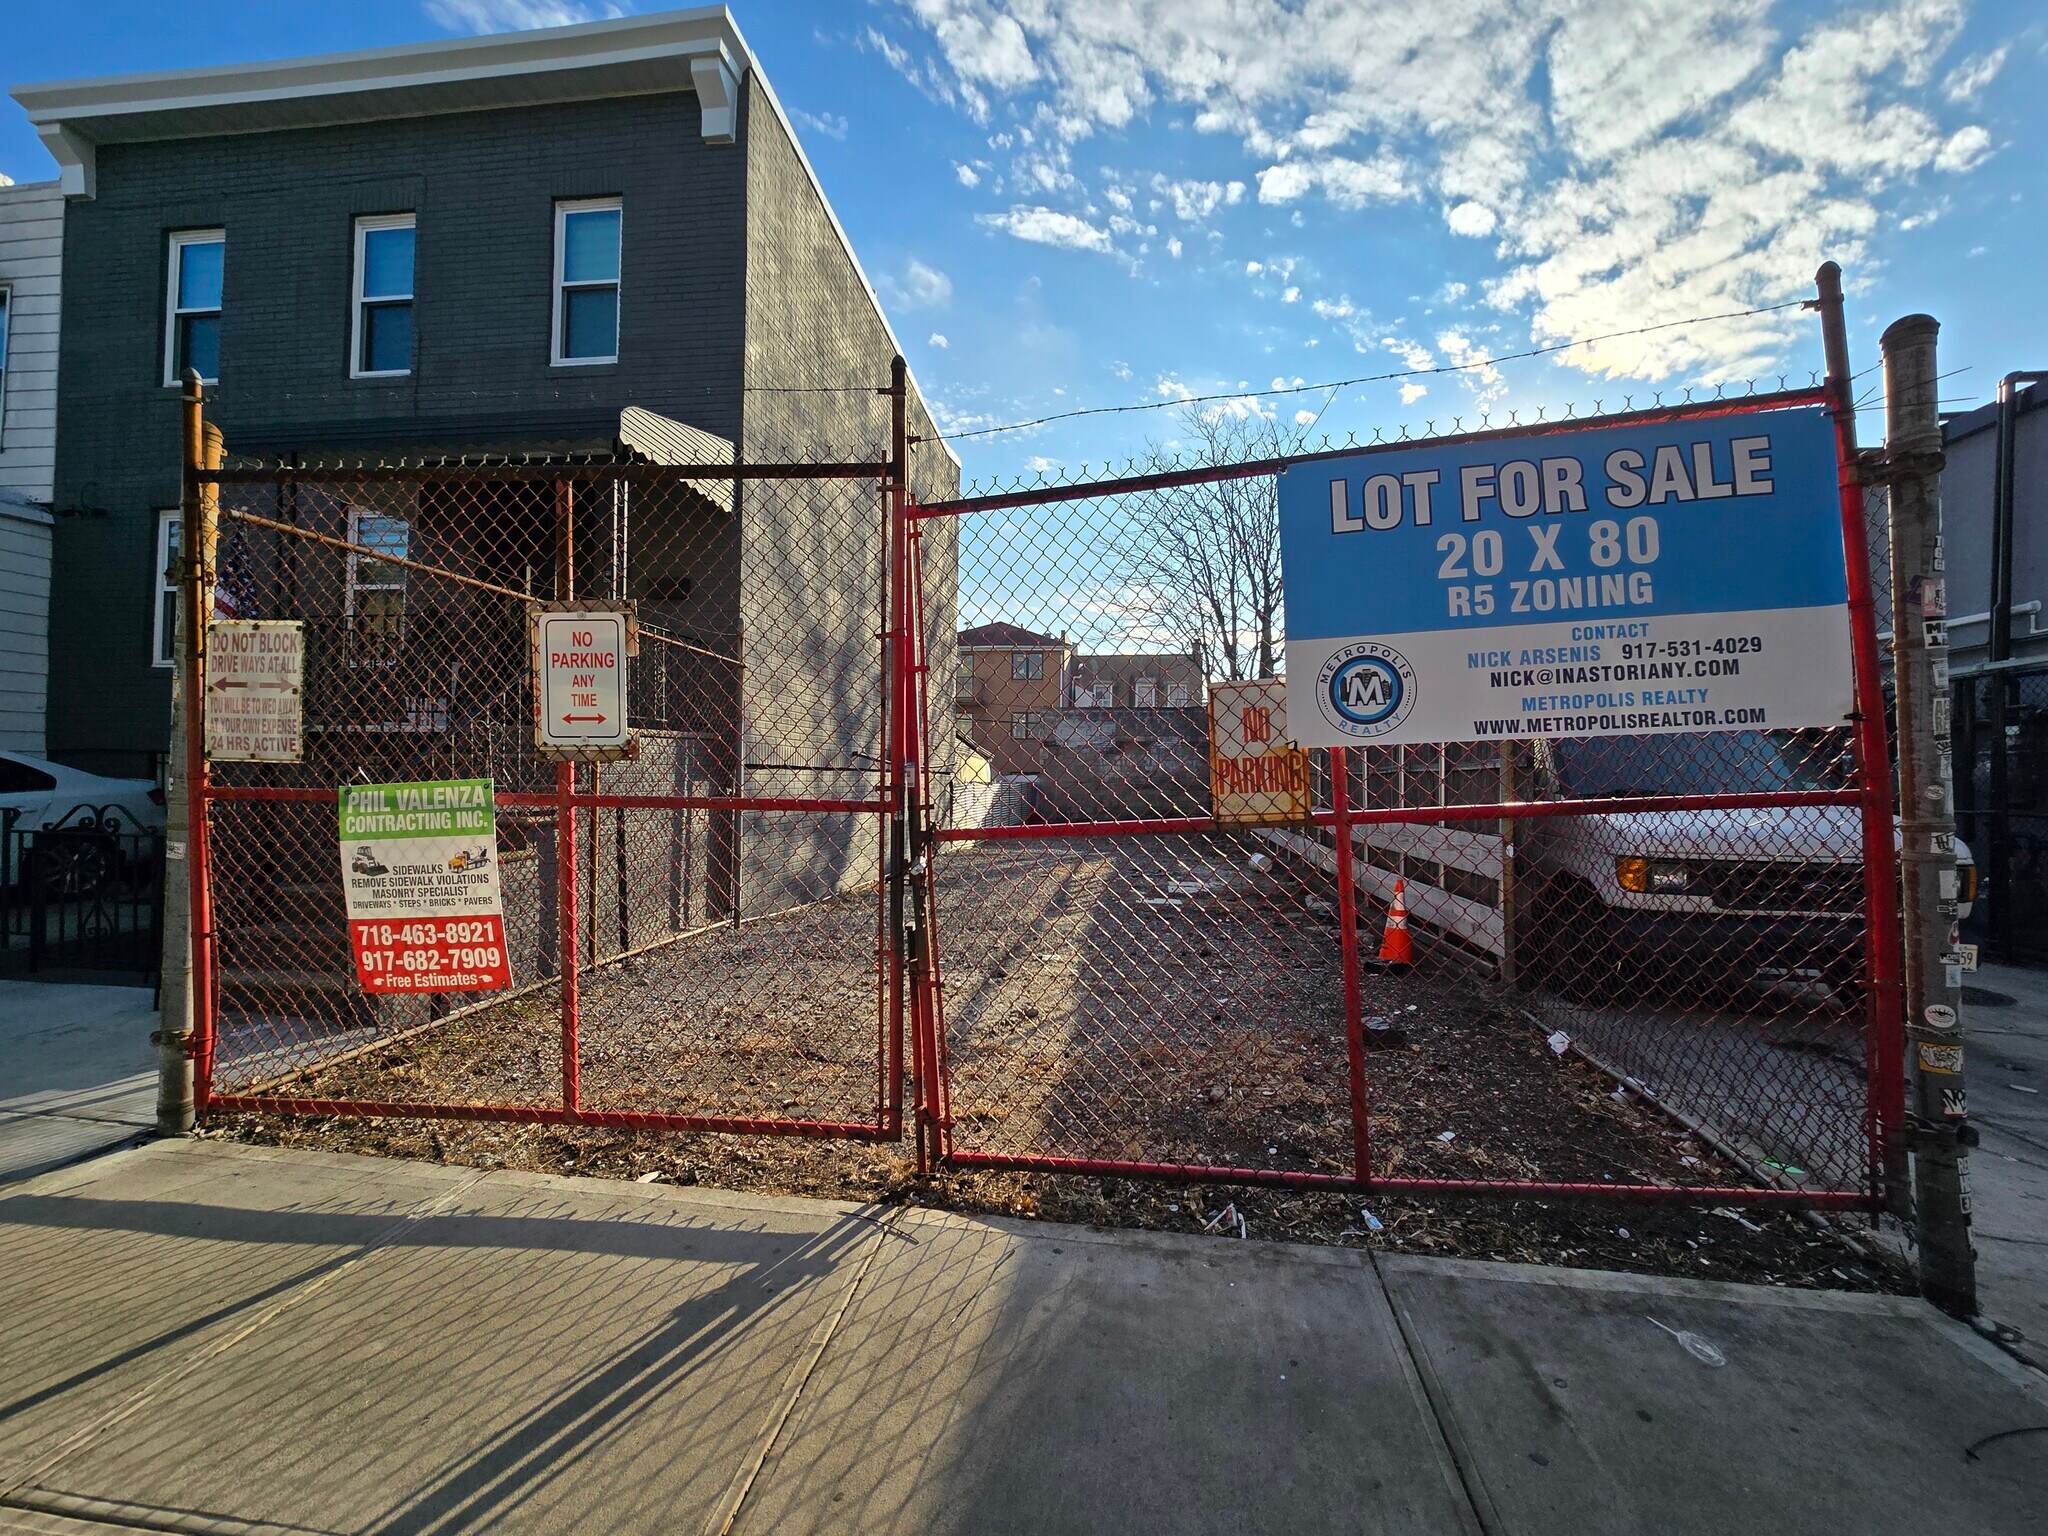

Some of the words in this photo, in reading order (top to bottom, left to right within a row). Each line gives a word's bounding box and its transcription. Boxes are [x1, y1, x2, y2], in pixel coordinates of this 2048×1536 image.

[1328, 469, 1440, 535] LOT
[1458, 456, 1588, 522] FOR
[1604, 433, 1774, 509] SALE
[1437, 529, 1503, 579] 20
[1528, 523, 1566, 572] X
[1589, 516, 1660, 567] 80
[1447, 584, 1495, 617] R5
[1510, 571, 1653, 613] ZONING
[572, 631, 593, 647] NO
[1571, 622, 1649, 641] CONTACT
[212, 632, 228, 653] DO
[231, 633, 256, 653] NOT
[259, 633, 298, 654] BLOCK
[1467, 649, 1512, 669] NICK
[1519, 644, 1602, 666] ARSENIS
[1621, 637, 1763, 661] 917-531-4029
[211, 656, 238, 673] DRIVE
[240, 656, 265, 673] WAYS
[268, 656, 279, 673] AT
[280, 657, 297, 674] ALL
[552, 652, 615, 669] PARKING
[1319, 645, 1412, 684] METROPOLIS
[572, 674, 596, 688] ANY
[1489, 659, 1741, 689] NICK@INASTORIANY.COM
[210, 697, 224, 714] YOU
[224, 697, 240, 714] WILL
[241, 697, 250, 714] BE
[277, 698, 298, 715] AWAY
[571, 693, 597, 707] TIME
[1521, 690, 1637, 712] METROPOLIS
[1641, 687, 1709, 708] REALTY
[210, 717, 219, 734] AT
[220, 717, 241, 734] YOUR
[242, 718, 260, 734] OWN
[261, 718, 297, 735] EXPENSE
[1242, 706, 1271, 743] NO
[1338, 712, 1402, 735] REALTY
[1473, 707, 1766, 736] WWW.METROPOLISREALTOR.COM
[210, 735, 224, 750] 24
[226, 736, 251, 752] HRS
[254, 737, 297, 753] ACTIVE
[1218, 755, 1303, 795] PARKING
[347, 790, 391, 814] PHIL
[395, 786, 487, 811] VALENZA
[345, 812, 452, 833] CONTRACTING
[456, 810, 488, 828] INC.
[392, 863, 444, 876] SIDEWALKS
[351, 876, 387, 889] REMOVE
[389, 875, 434, 887] SIDEWALK
[436, 873, 490, 886] VIOLATIONS
[372, 887, 415, 899] MASONRY
[417, 885, 469, 898] SPECIALIST
[353, 899, 392, 910] DRIVEWAYS
[398, 898, 422, 909] STEPS
[429, 897, 457, 908] BRICKS
[463, 896, 493, 906] PAVERS
[357, 921, 495, 946] 718-463-8921
[361, 947, 501, 972] 917-682-7909
[386, 974, 412, 989] Free
[414, 973, 478, 987] Estimates
